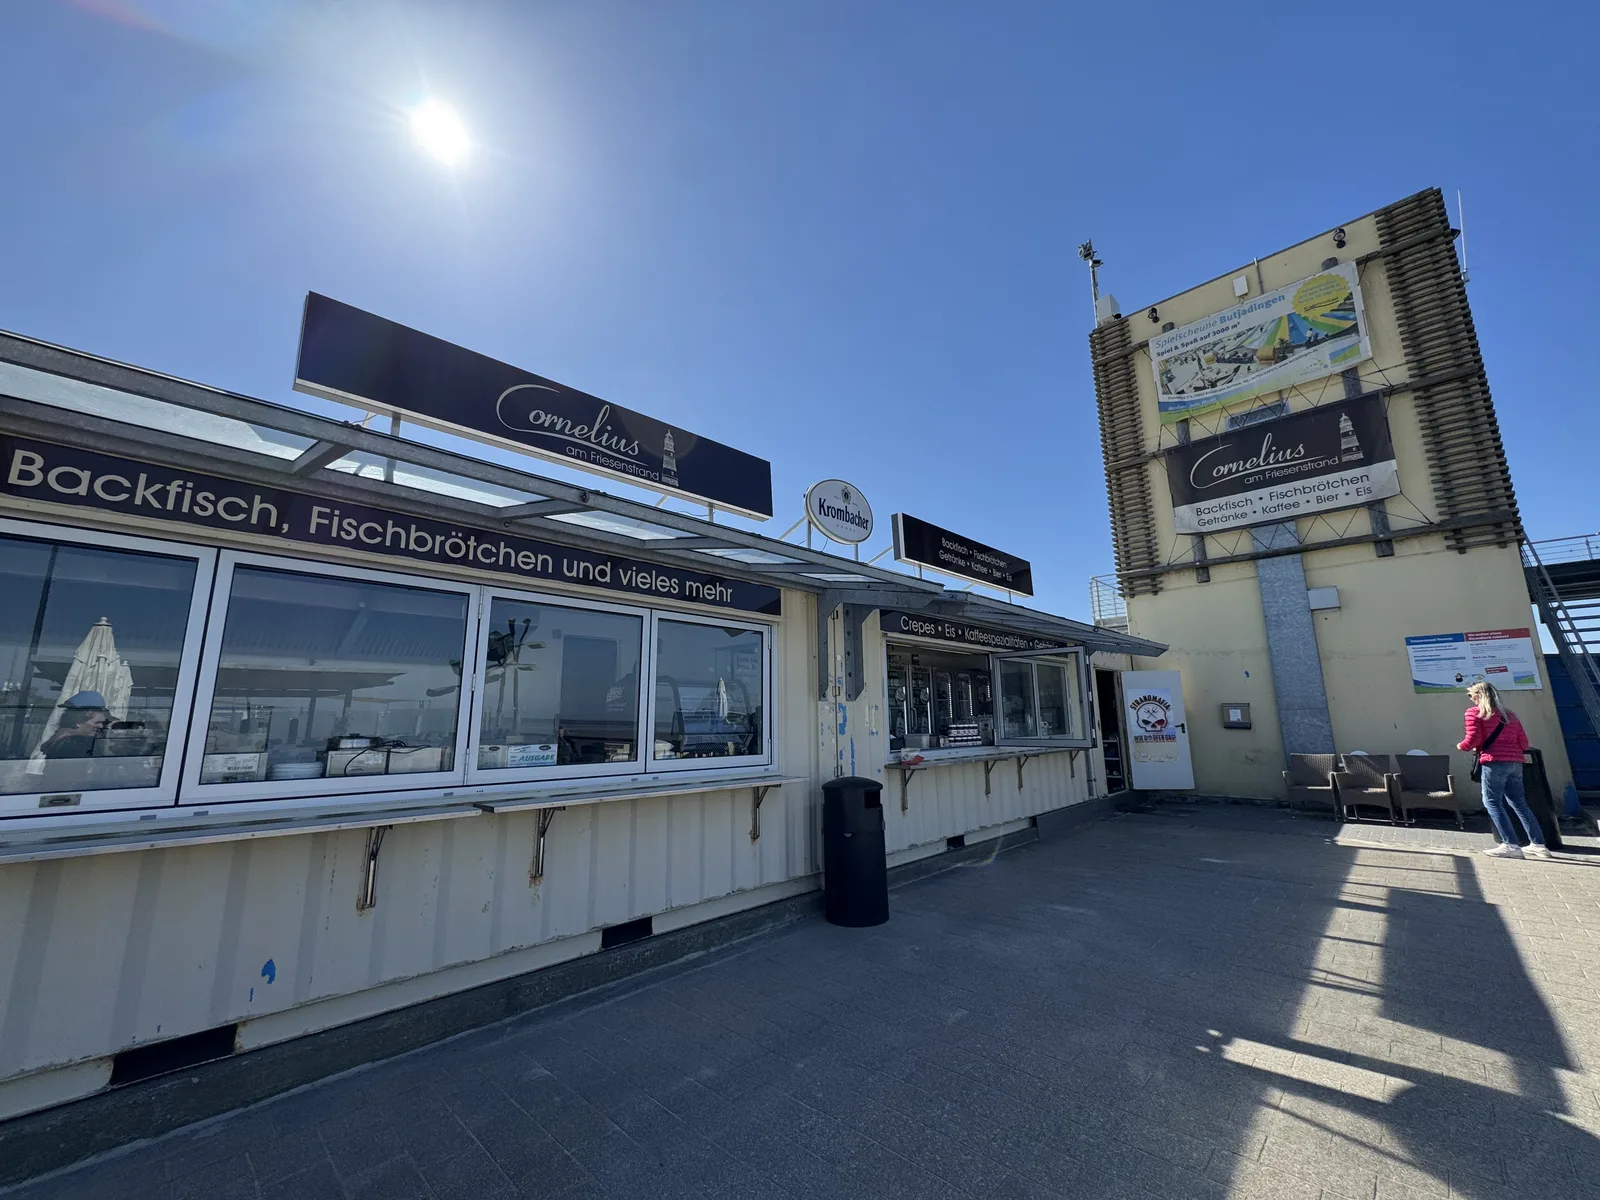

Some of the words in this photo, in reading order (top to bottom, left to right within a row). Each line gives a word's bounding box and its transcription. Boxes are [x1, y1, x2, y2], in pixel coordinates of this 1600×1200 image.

[1155, 319, 1218, 349] Spielscheune
[1219, 294, 1286, 324] Butjadingen
[1156, 347, 1174, 358] Spiel
[1180, 337, 1199, 349] Spaß
[1199, 332, 1211, 343] auf
[1212, 325, 1230, 337] 3000
[496, 384, 645, 461] Cornelius
[565, 445, 588, 460] am
[590, 450, 660, 481] Friesenstrand
[1190, 432, 1308, 489] Cornelius
[1244, 473, 1264, 485] am
[1265, 456, 1339, 480] Friesenstrand
[1195, 497, 1253, 517] Backfisch
[1268, 473, 1370, 502] Fischbrötchen
[1197, 510, 1248, 527] Getränke
[1261, 500, 1301, 515] Kaffee
[1315, 493, 1340, 505] Bier
[1356, 485, 1373, 497] Eis
[7, 449, 290, 534] Backfisch,
[308, 504, 554, 574] Fischbrötchen
[561, 556, 611, 584] und
[619, 566, 680, 596] vieles
[684, 580, 733, 603] mehr
[818, 497, 870, 531] Krombacher
[938, 549, 966, 567] Getränke
[970, 560, 988, 574] Kaffee
[992, 568, 1002, 578] Bier
[941, 537, 969, 555] Backfisch
[973, 549, 1008, 568] Fischbrötchen
[900, 615, 936, 636] Crepes
[944, 623, 956, 638] Eis
[964, 626, 1029, 650] Kaffeespezialitäten
[1129, 694, 1172, 711] STRANDMAFIA
[518, 753, 555, 762] AUSGABE
